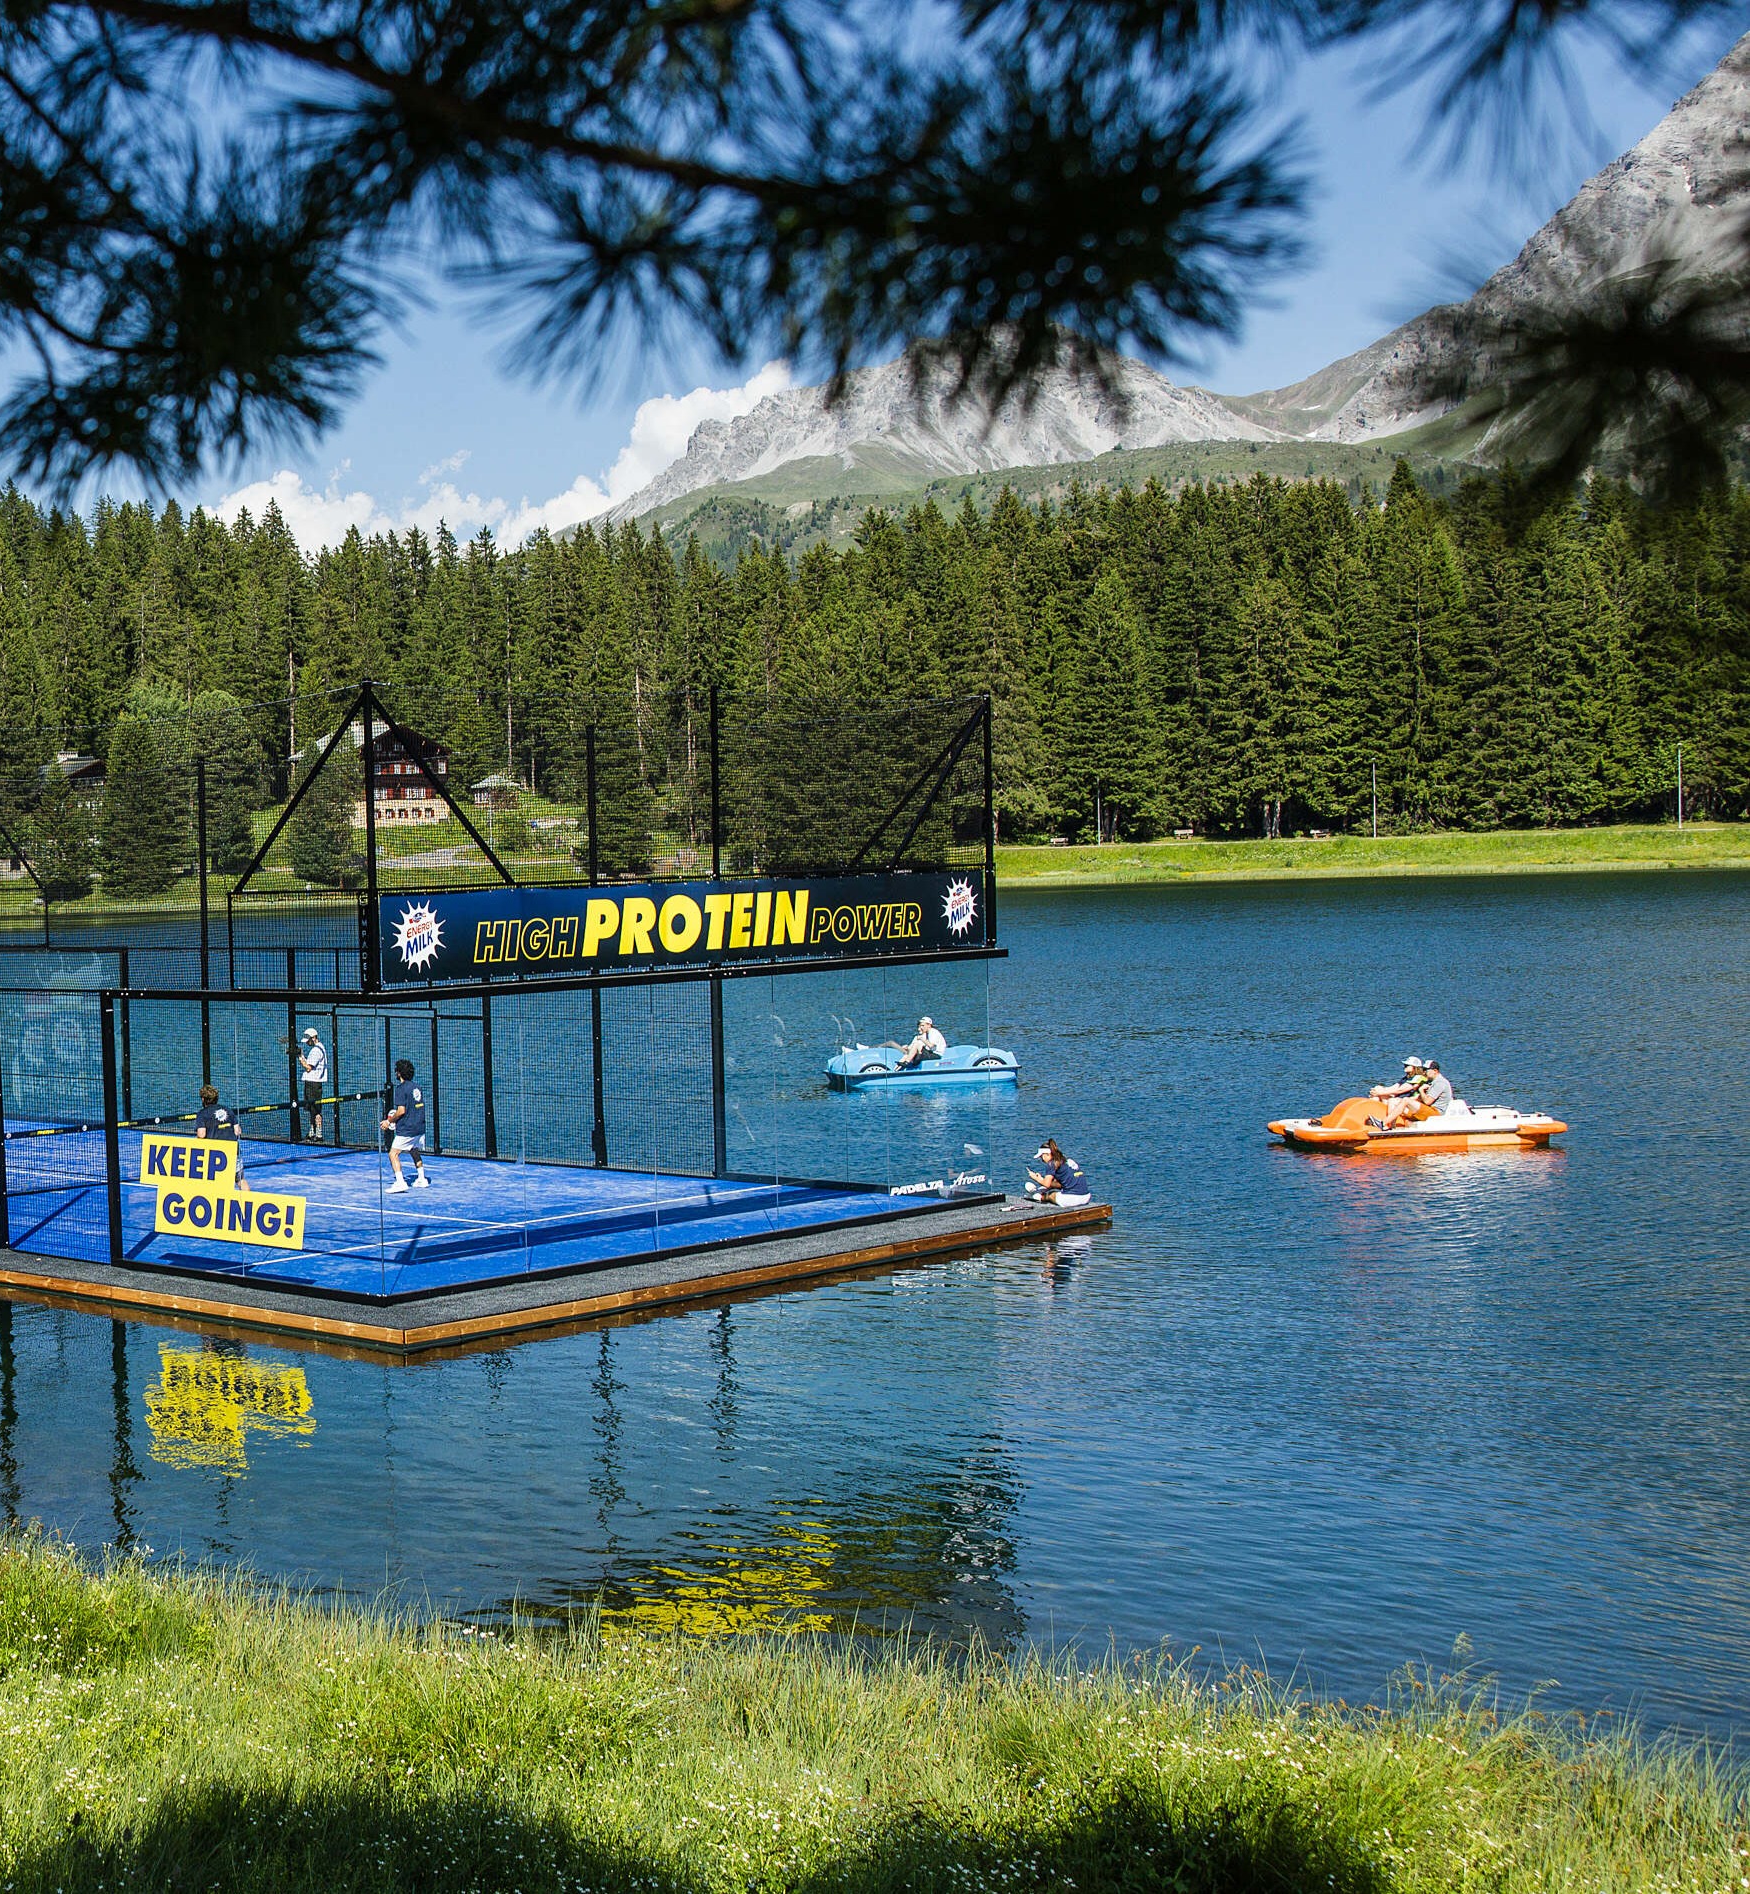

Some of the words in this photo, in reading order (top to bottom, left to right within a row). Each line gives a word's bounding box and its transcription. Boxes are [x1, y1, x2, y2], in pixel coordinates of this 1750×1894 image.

[406, 921, 434, 939] ENERGY
[473, 917, 579, 963] HIGH
[581, 890, 810, 957] PROTEIN
[810, 903, 922, 944] POWER
[405, 930, 434, 960] MILK
[147, 1144, 228, 1181] KEEP
[890, 1180, 944, 1197] PADELTA
[950, 1171, 986, 1189] Arosa
[162, 1193, 296, 1239] GOING!
